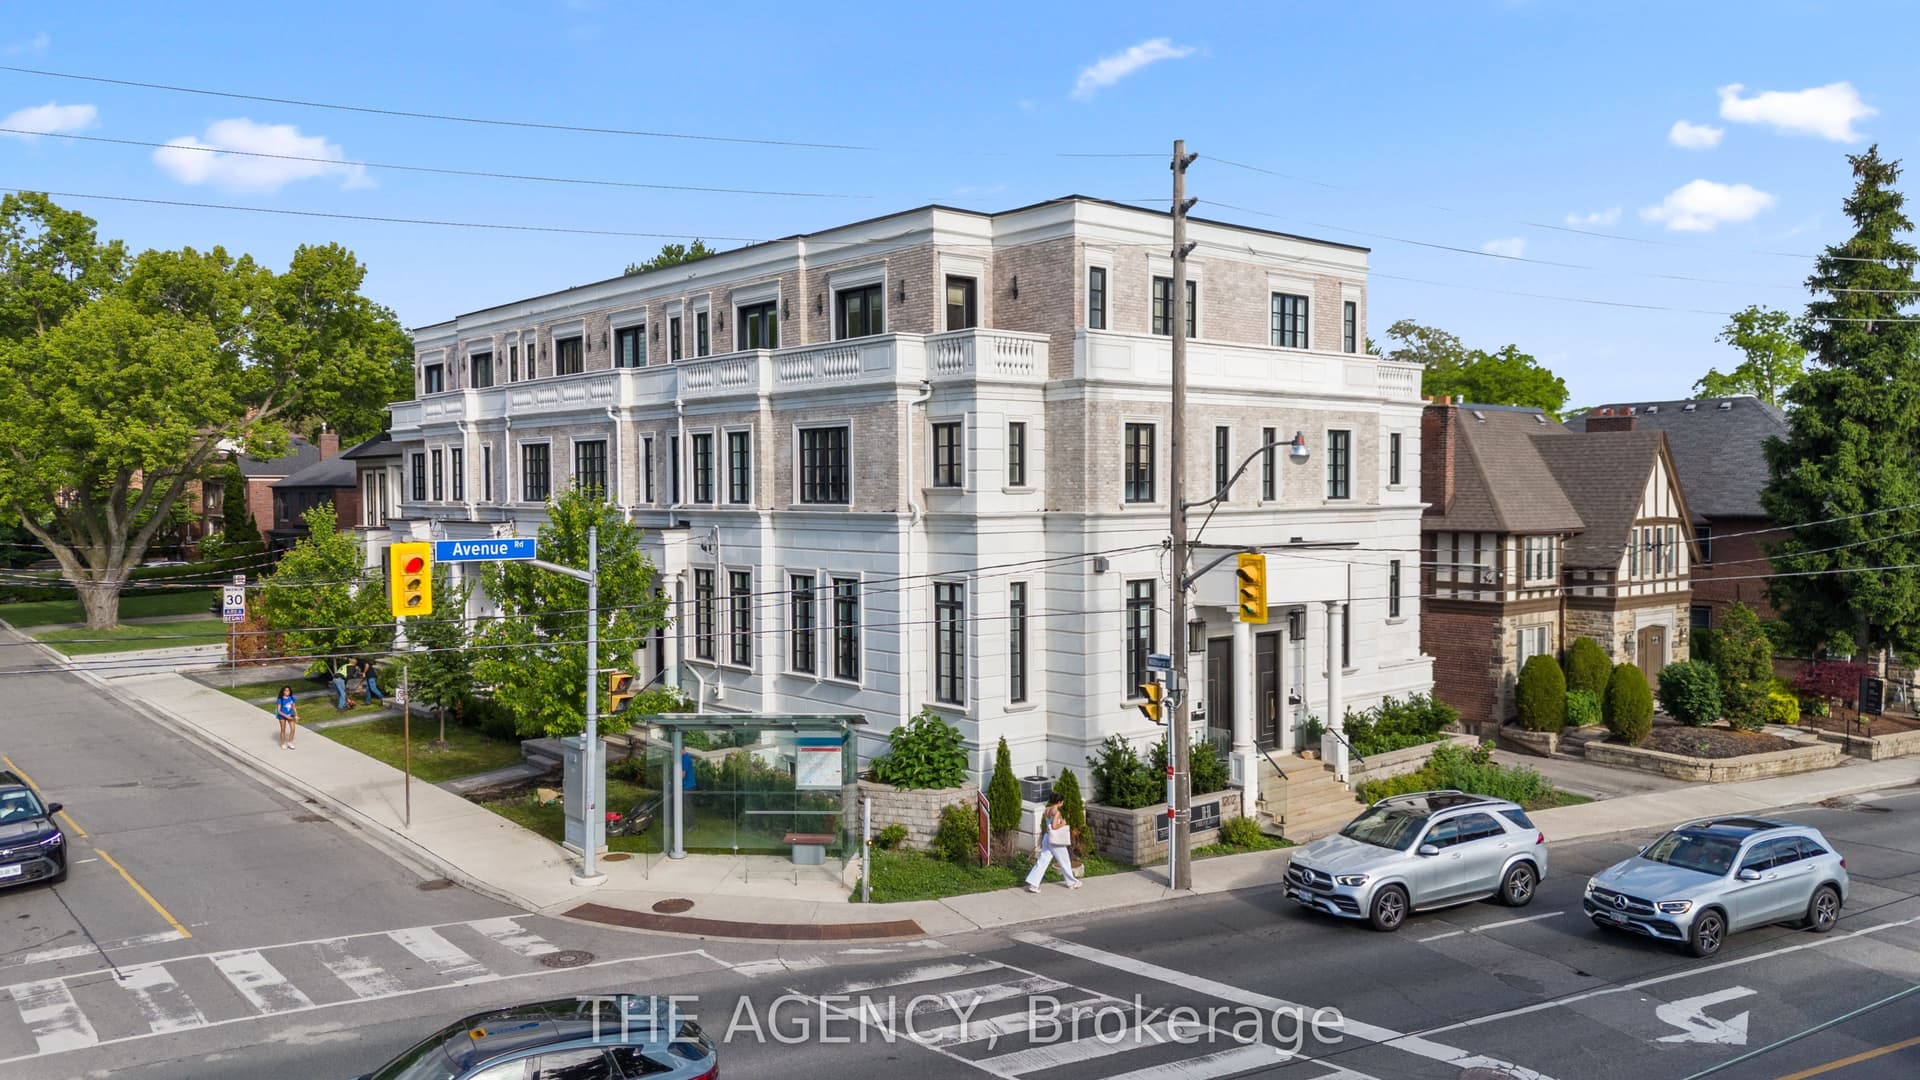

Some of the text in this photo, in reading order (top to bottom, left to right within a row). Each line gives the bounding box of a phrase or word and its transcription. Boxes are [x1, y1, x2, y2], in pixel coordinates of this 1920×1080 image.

[452, 541, 524, 556] Avenue Rd
[226, 594, 243, 605] 30
